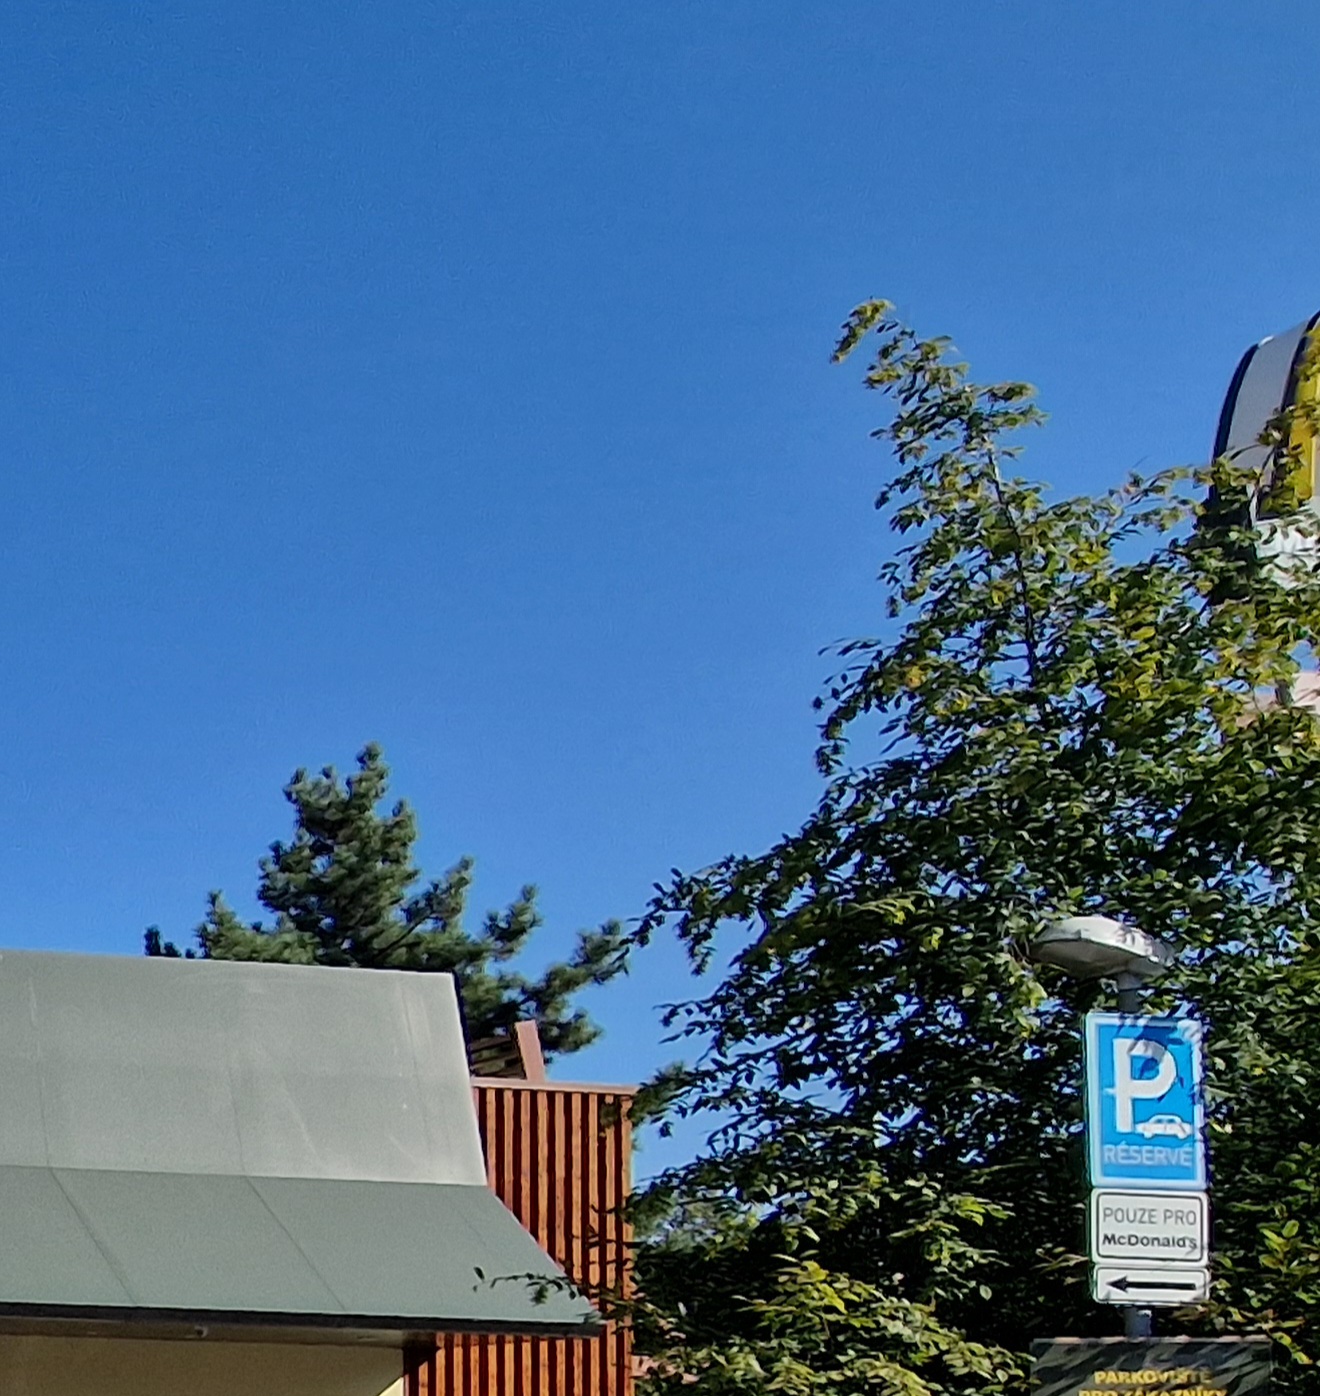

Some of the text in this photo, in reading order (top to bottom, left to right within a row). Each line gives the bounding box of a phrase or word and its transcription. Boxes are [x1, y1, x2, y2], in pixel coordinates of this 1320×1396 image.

[1113, 1037, 1177, 1133] P
[1103, 1207, 1196, 1225] POUZE PRO
